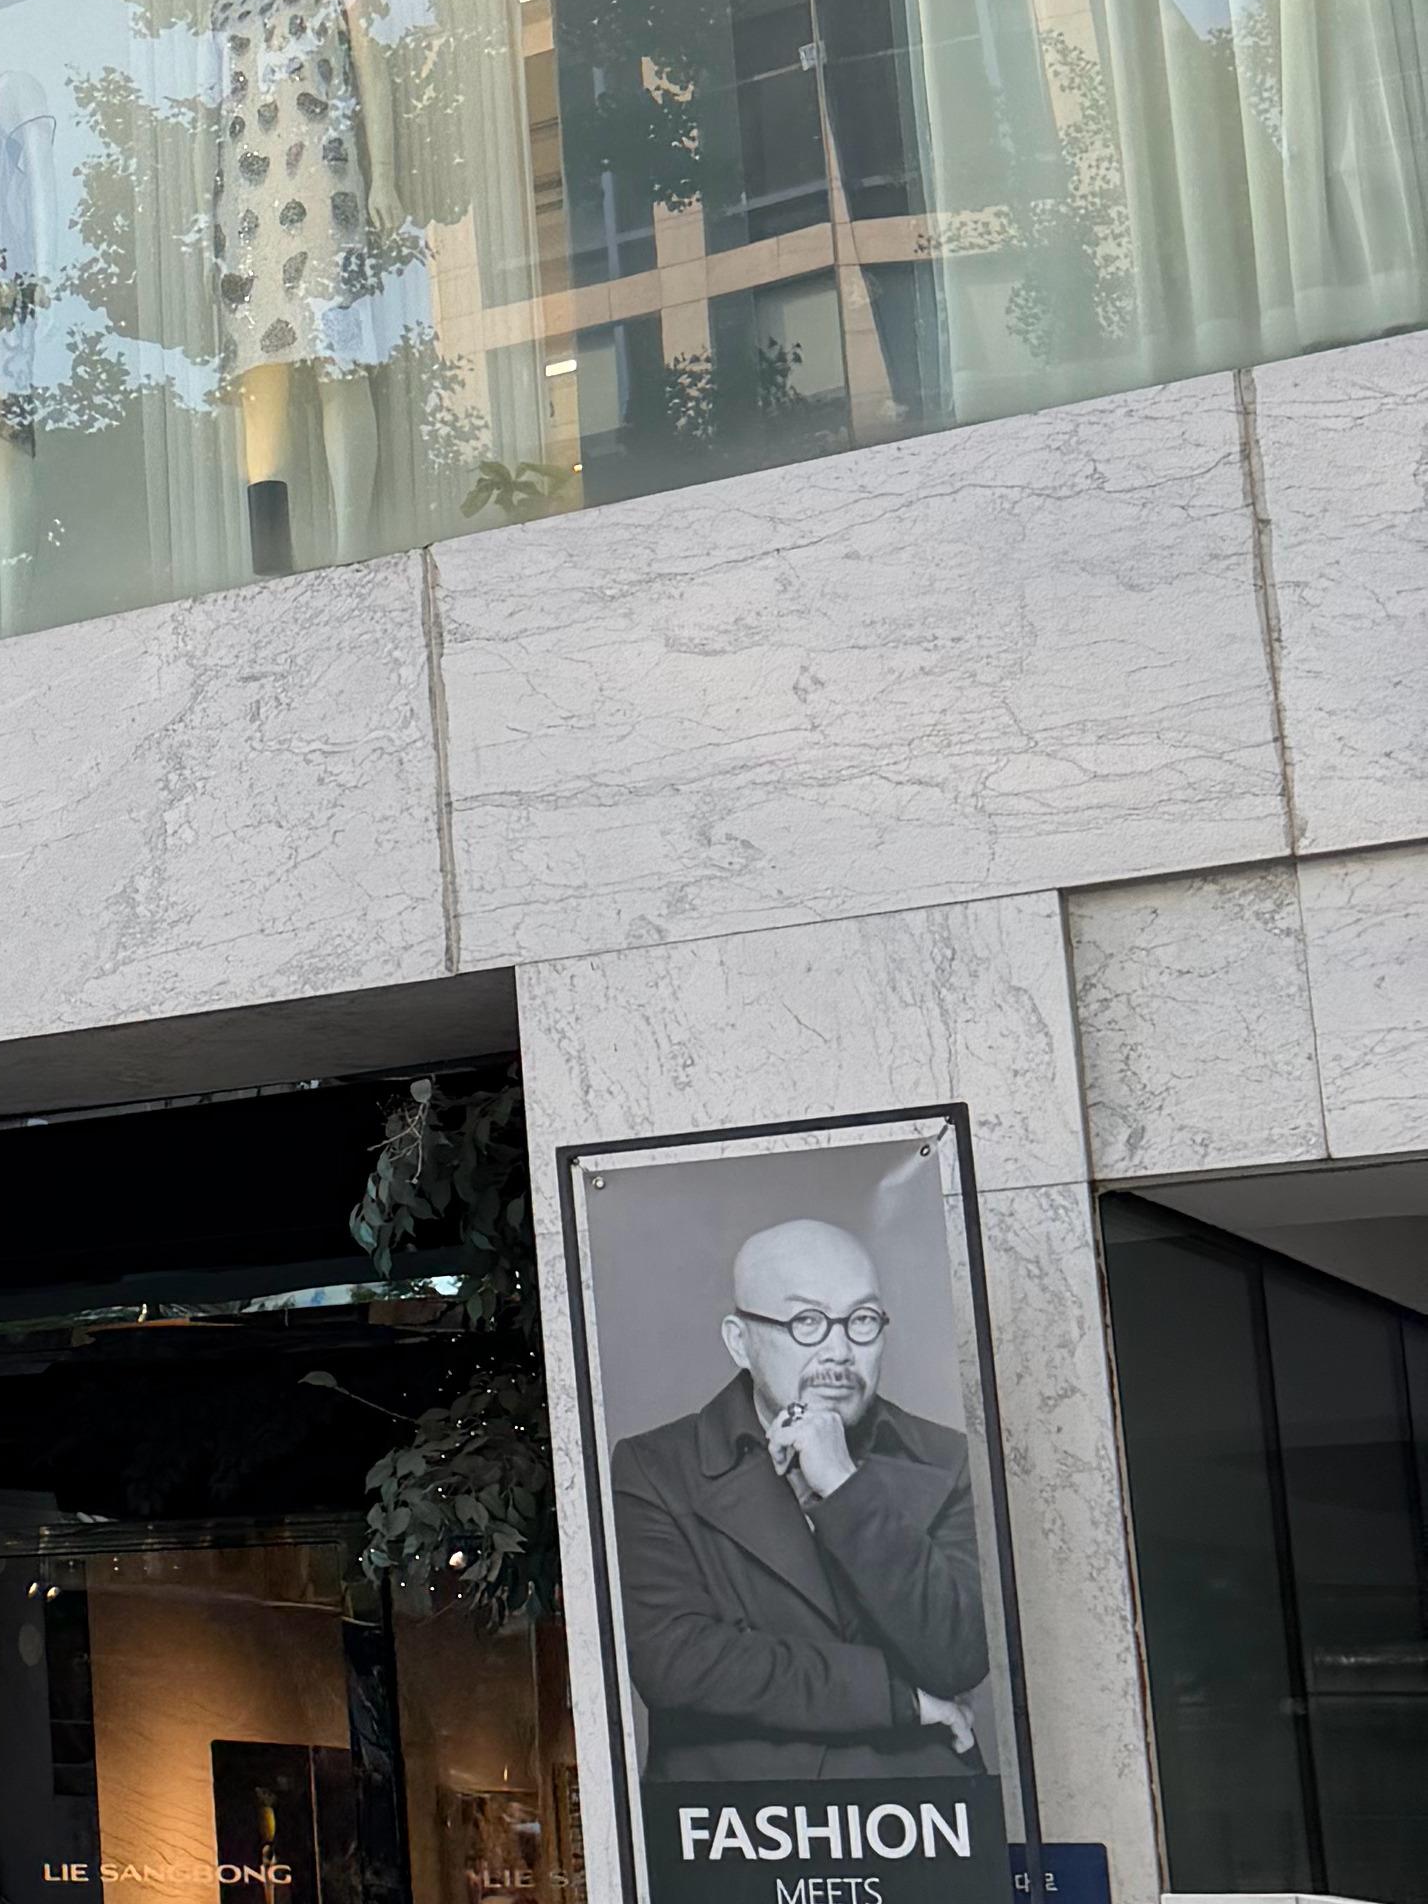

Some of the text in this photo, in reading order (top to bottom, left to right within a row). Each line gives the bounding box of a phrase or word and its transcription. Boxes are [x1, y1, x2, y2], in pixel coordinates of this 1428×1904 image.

[678, 1802, 971, 1860] FASHION
[43, 1863, 293, 1885] LIE SANGBONG
[484, 1869, 536, 1888] LIE
